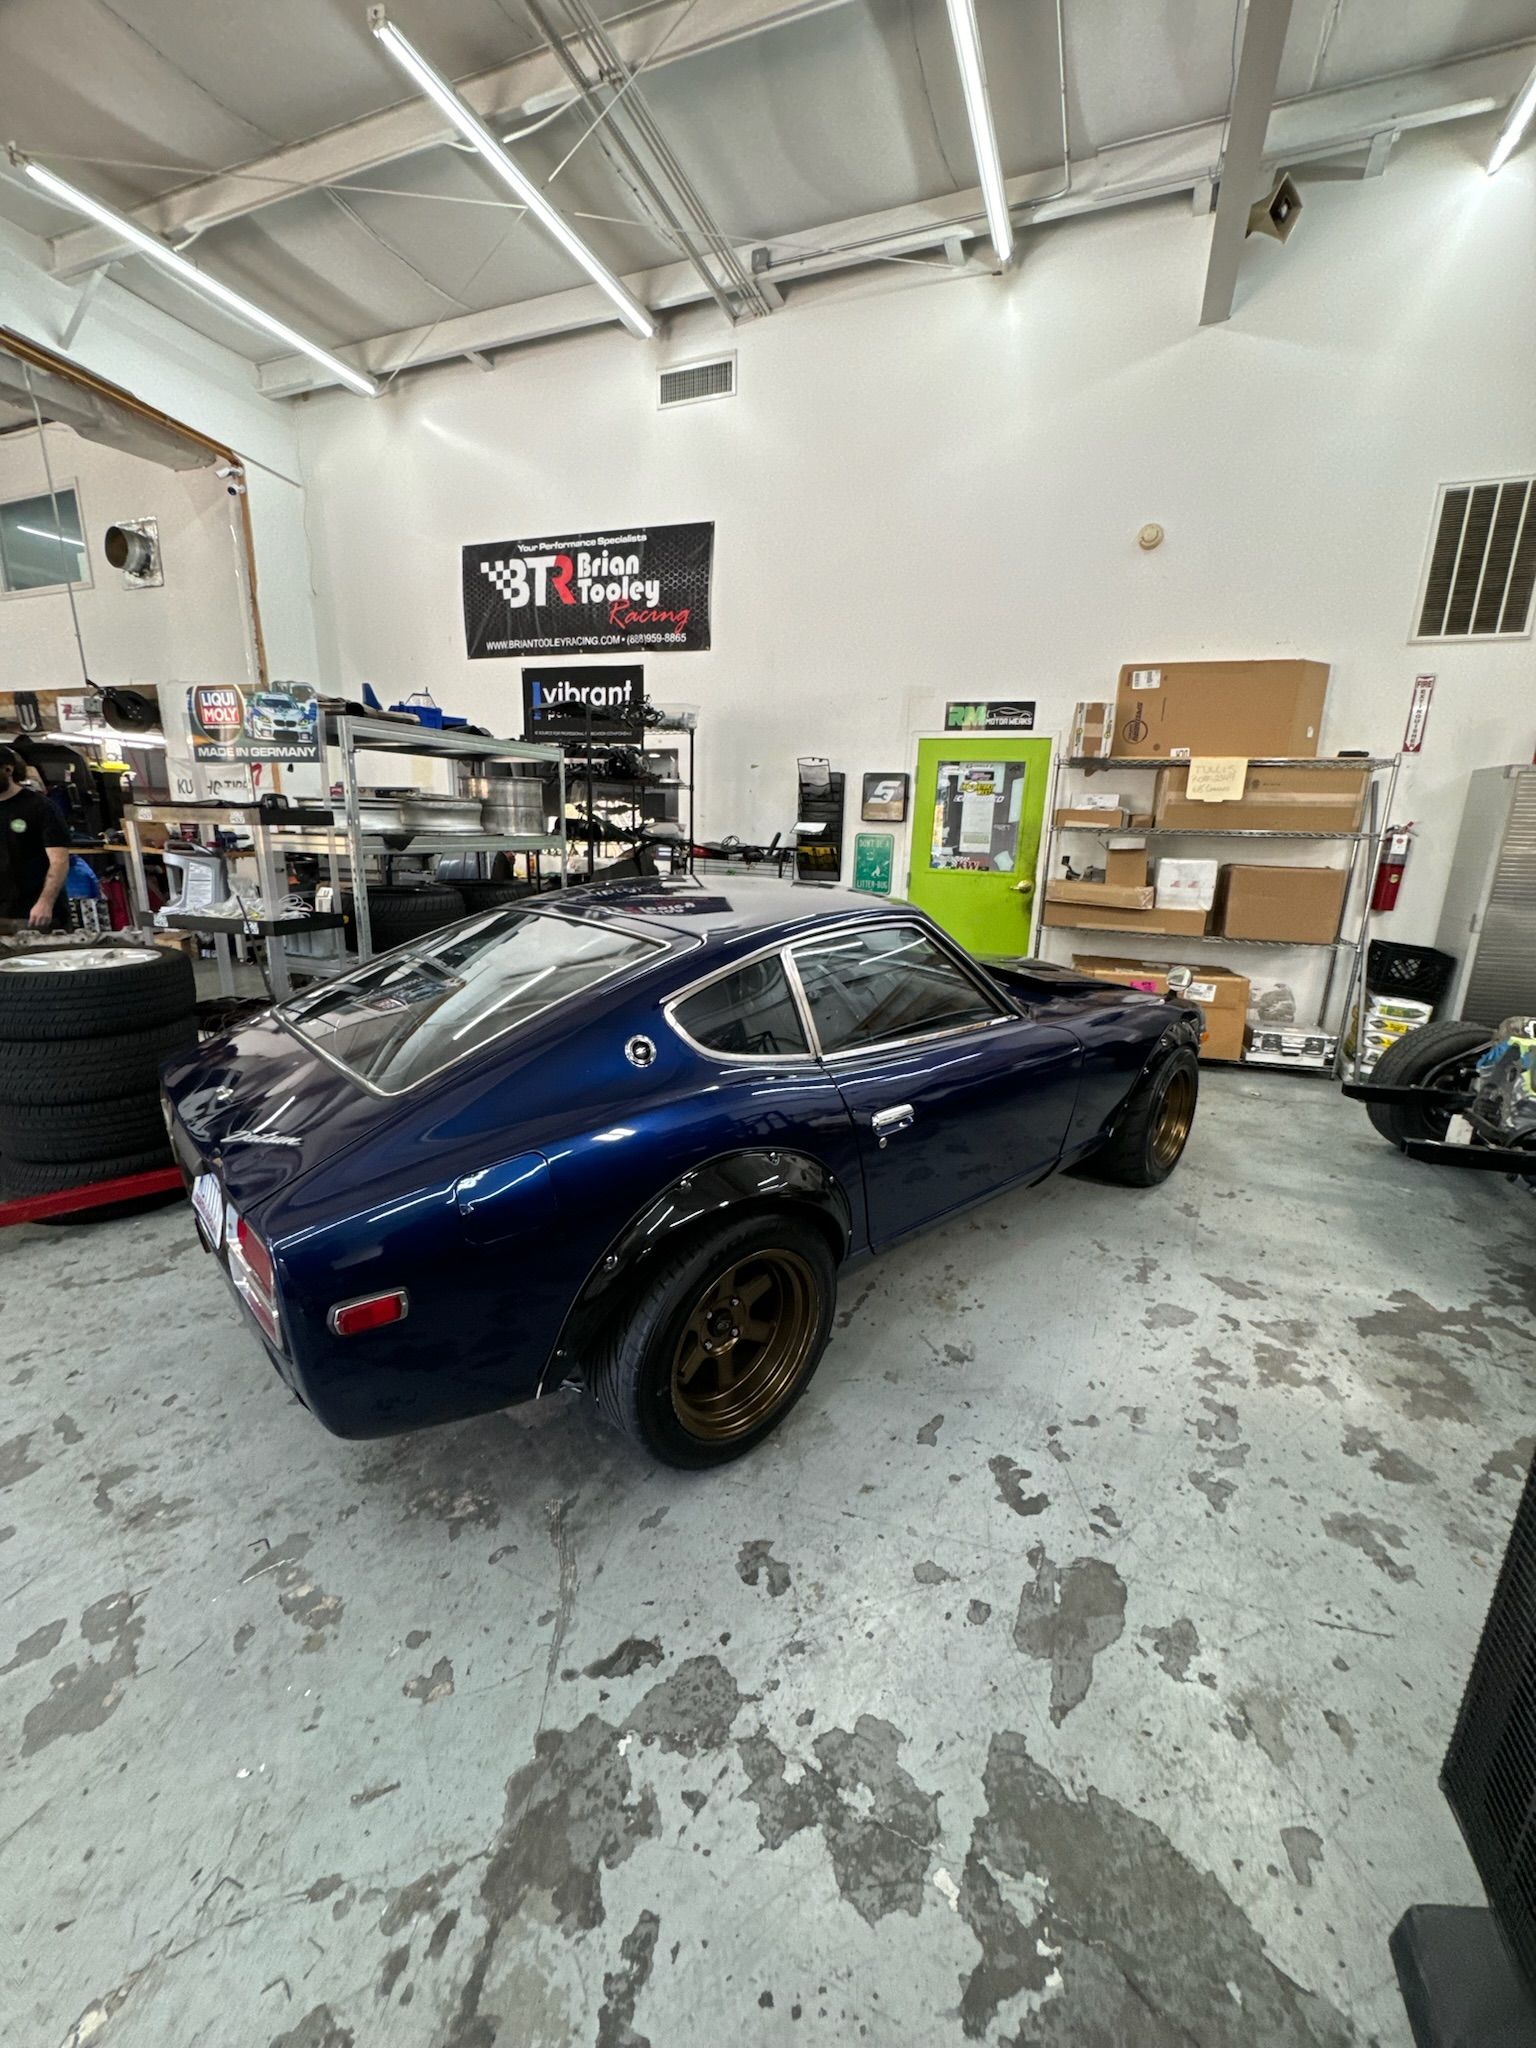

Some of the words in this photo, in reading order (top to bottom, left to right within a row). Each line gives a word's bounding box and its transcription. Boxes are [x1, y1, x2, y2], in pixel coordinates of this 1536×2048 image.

[517, 543, 539, 553] Your
[539, 538, 596, 551] Performance
[597, 533, 647, 546] Specialists
[577, 550, 640, 579] Brian
[509, 553, 577, 609] BTR
[577, 576, 660, 608] Tooley
[609, 598, 691, 634] Racing
[486, 634, 620, 650] WWW.BRIANTOOLEYRACING.COM
[200, 692, 235, 707] LIQUI
[542, 680, 633, 706] vibrant
[203, 706, 239, 723] MOLY
[198, 747, 235, 758] MADE
[236, 747, 249, 757] IN
[250, 747, 316, 757] GERMANY
